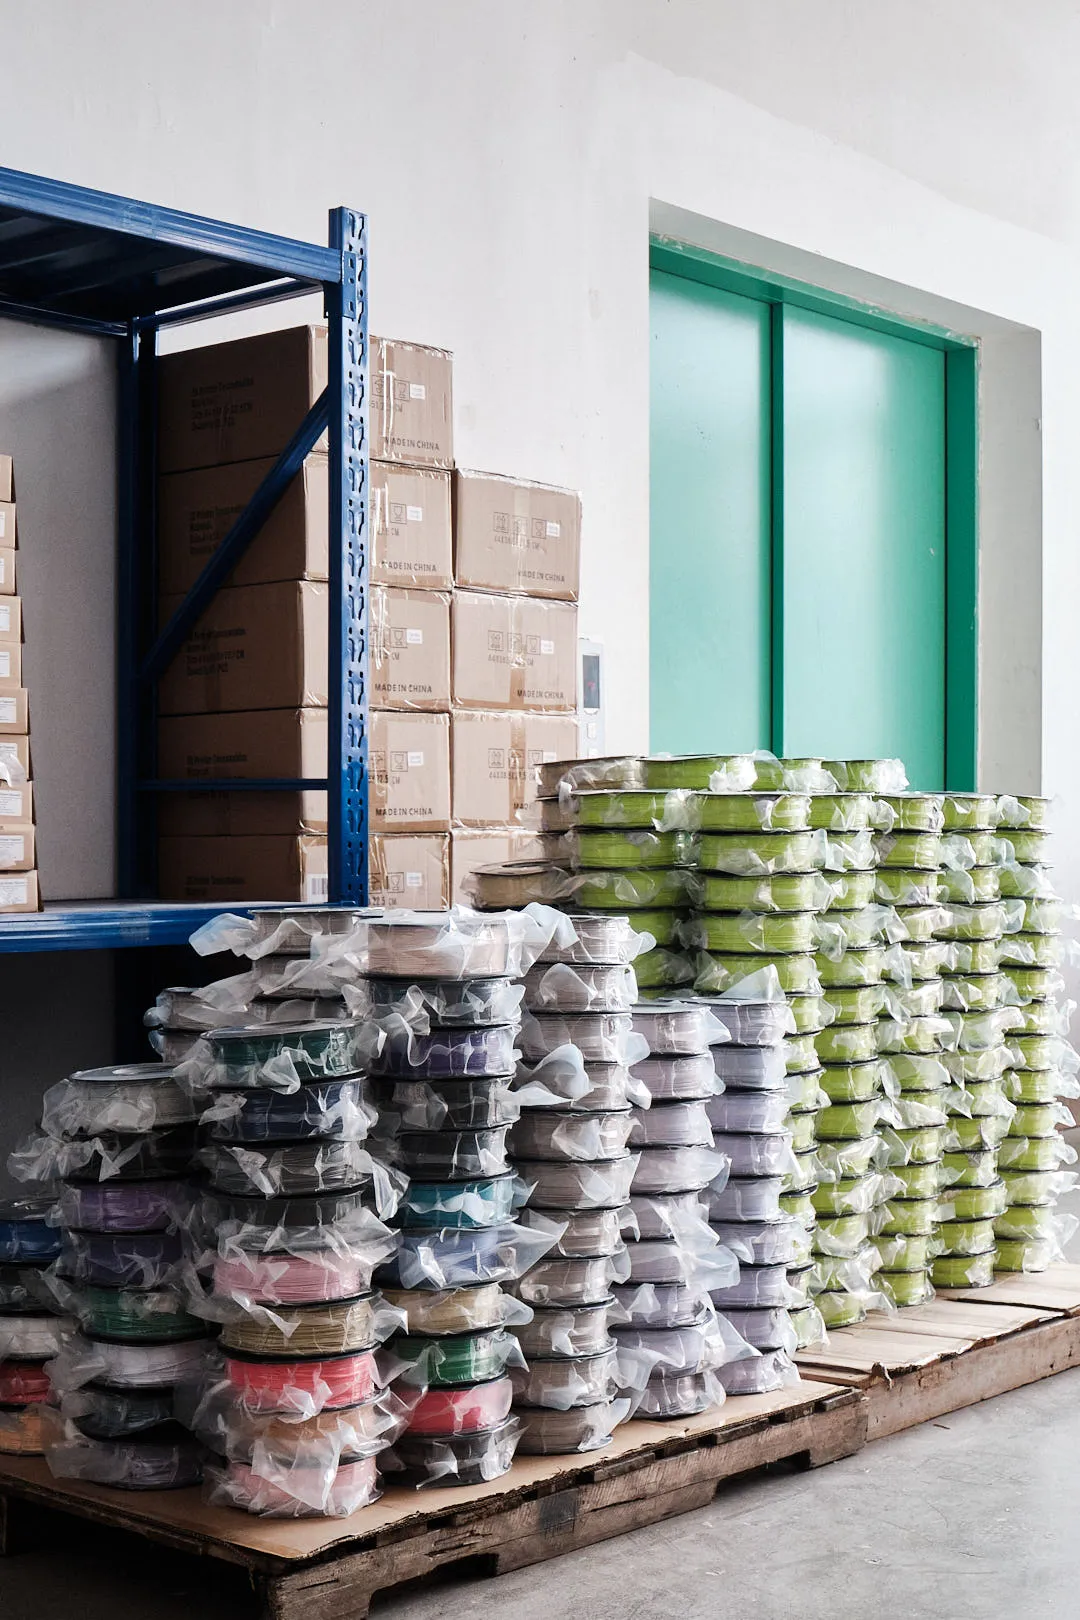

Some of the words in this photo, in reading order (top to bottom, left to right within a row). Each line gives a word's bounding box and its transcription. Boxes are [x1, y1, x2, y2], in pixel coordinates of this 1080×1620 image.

[406, 439, 416, 448] IN
[416, 439, 440, 450] CHINA
[403, 563, 412, 571] IN
[413, 563, 437, 572] CHINA
[544, 573, 566, 582] CHINA
[374, 683, 397, 692] MADE
[397, 684, 407, 692] IN
[408, 684, 433, 693] CHINA
[517, 689, 535, 698] MADE
[536, 690, 543, 698] IN
[544, 691, 564, 699] CHINA
[375, 808, 397, 816] MADE
[398, 808, 407, 816] IN
[408, 808, 433, 816] CHINA
